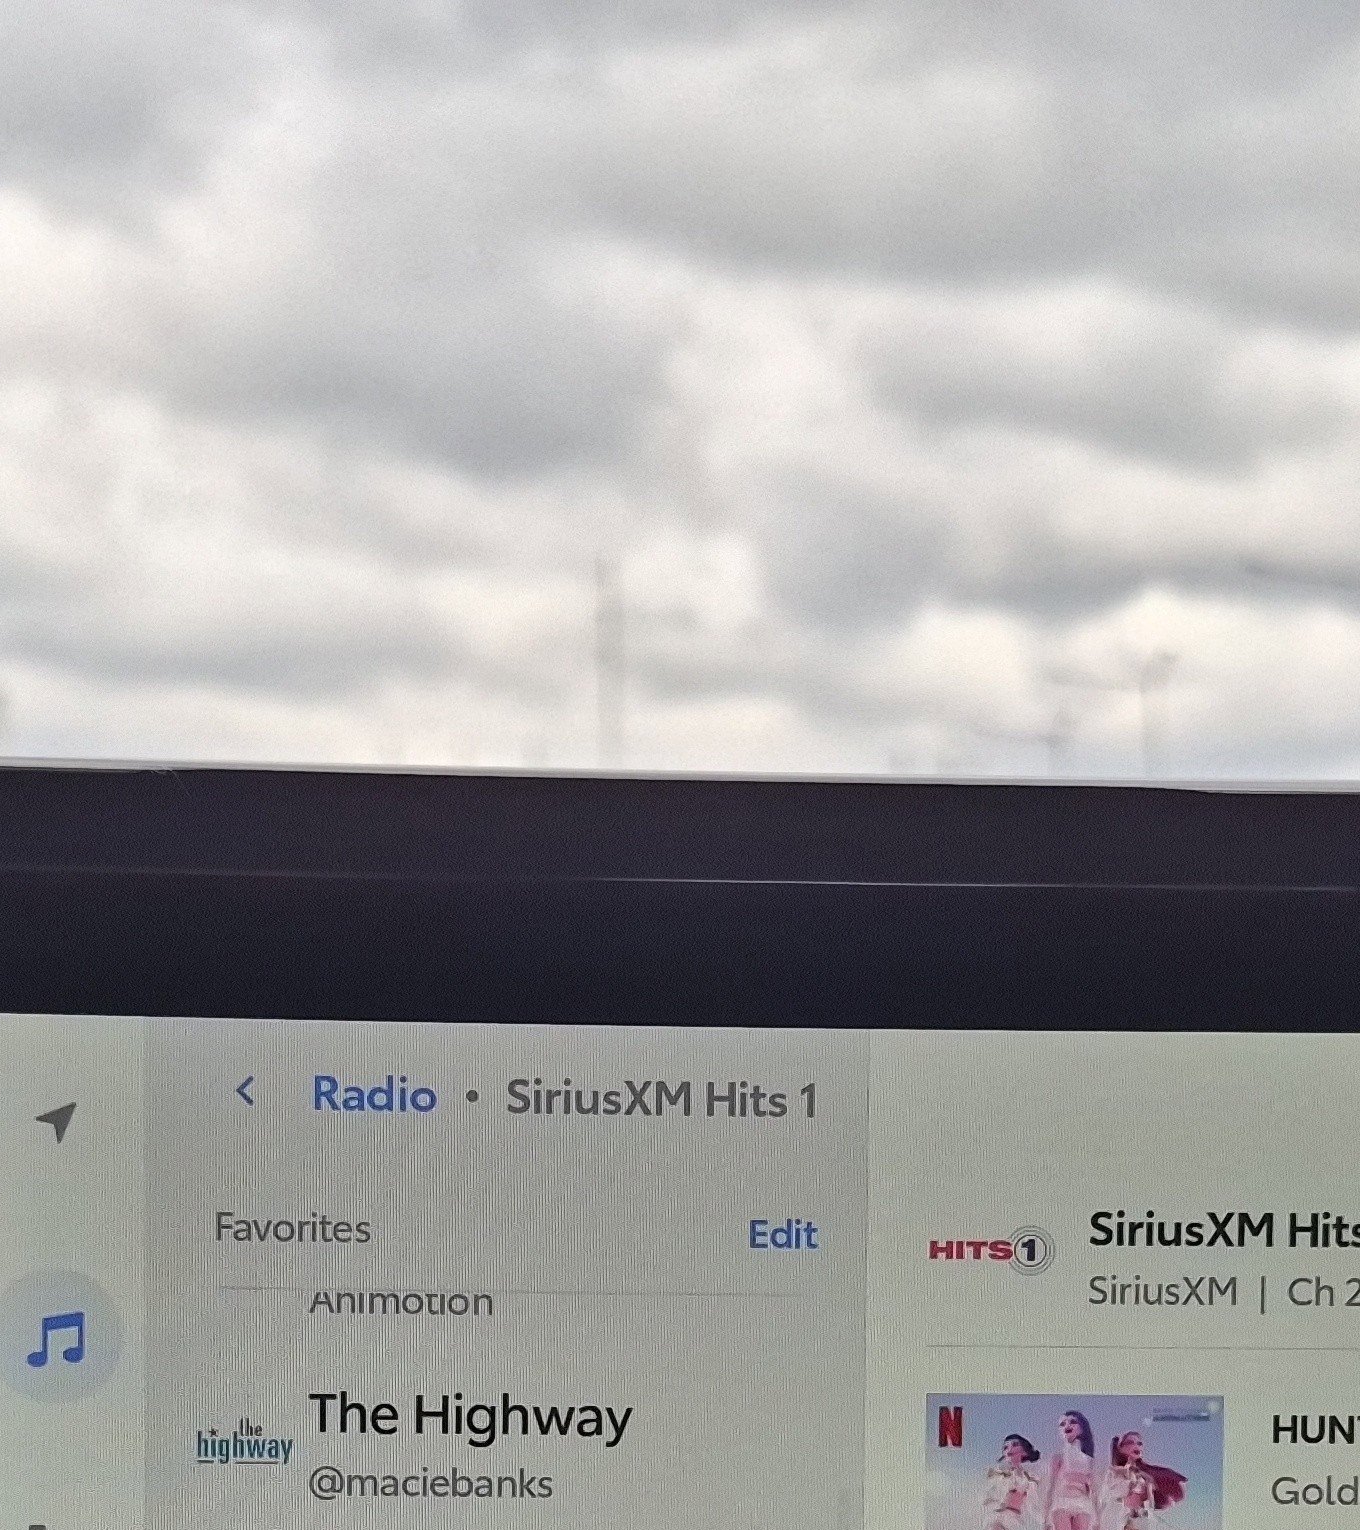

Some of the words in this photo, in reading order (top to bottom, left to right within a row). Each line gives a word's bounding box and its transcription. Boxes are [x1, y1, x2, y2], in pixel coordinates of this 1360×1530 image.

[313, 1074, 438, 1113] Radio
[507, 1077, 692, 1117] SiriusXM
[706, 1080, 788, 1118] Hits
[800, 1082, 816, 1119] 1
[215, 1210, 372, 1244] Favorites
[749, 1218, 818, 1250] Edit
[1089, 1209, 1275, 1248] SiriusXM
[1088, 1274, 1238, 1307] SiriusXM
[1287, 1275, 1335, 1307] Ch
[240, 1417, 263, 1437] the
[308, 1390, 399, 1436] The
[415, 1392, 633, 1448] Highway
[197, 1430, 293, 1465] highway
[308, 1465, 554, 1502] @maciebanks
